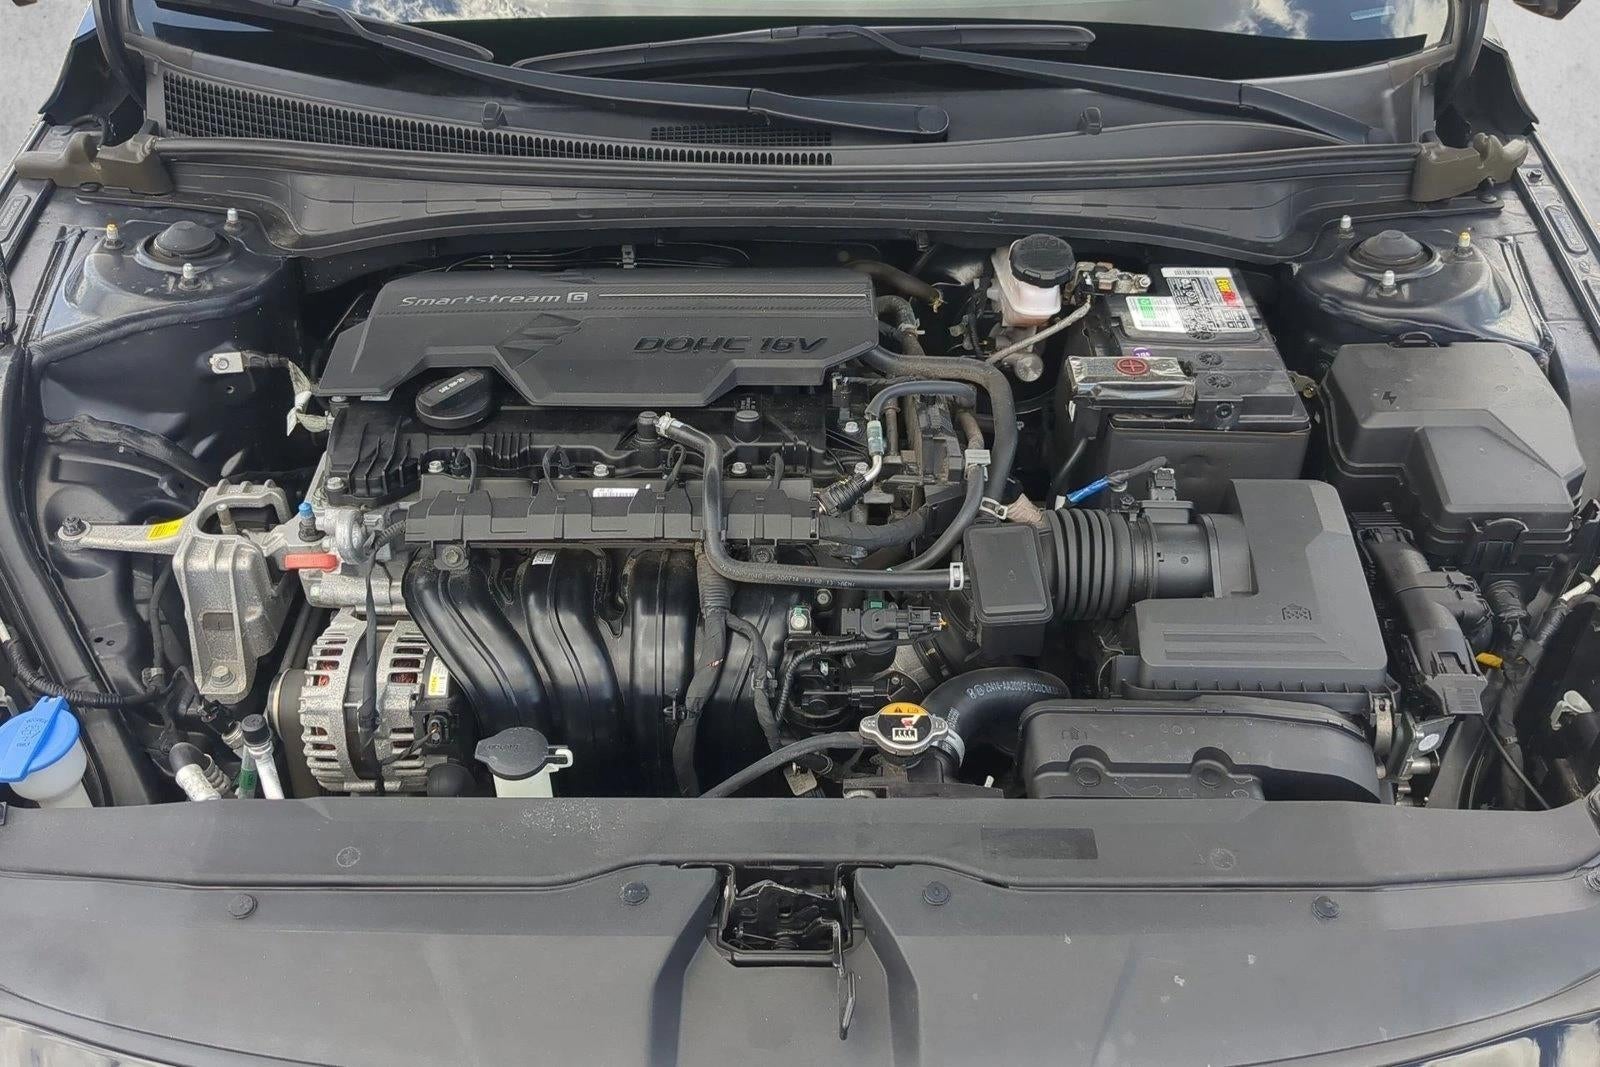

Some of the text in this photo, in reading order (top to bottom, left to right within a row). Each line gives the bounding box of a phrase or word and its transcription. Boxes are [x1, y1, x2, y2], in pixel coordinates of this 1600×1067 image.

[399, 294, 561, 307] Smartstream
[632, 335, 828, 353] DOHC 16V
